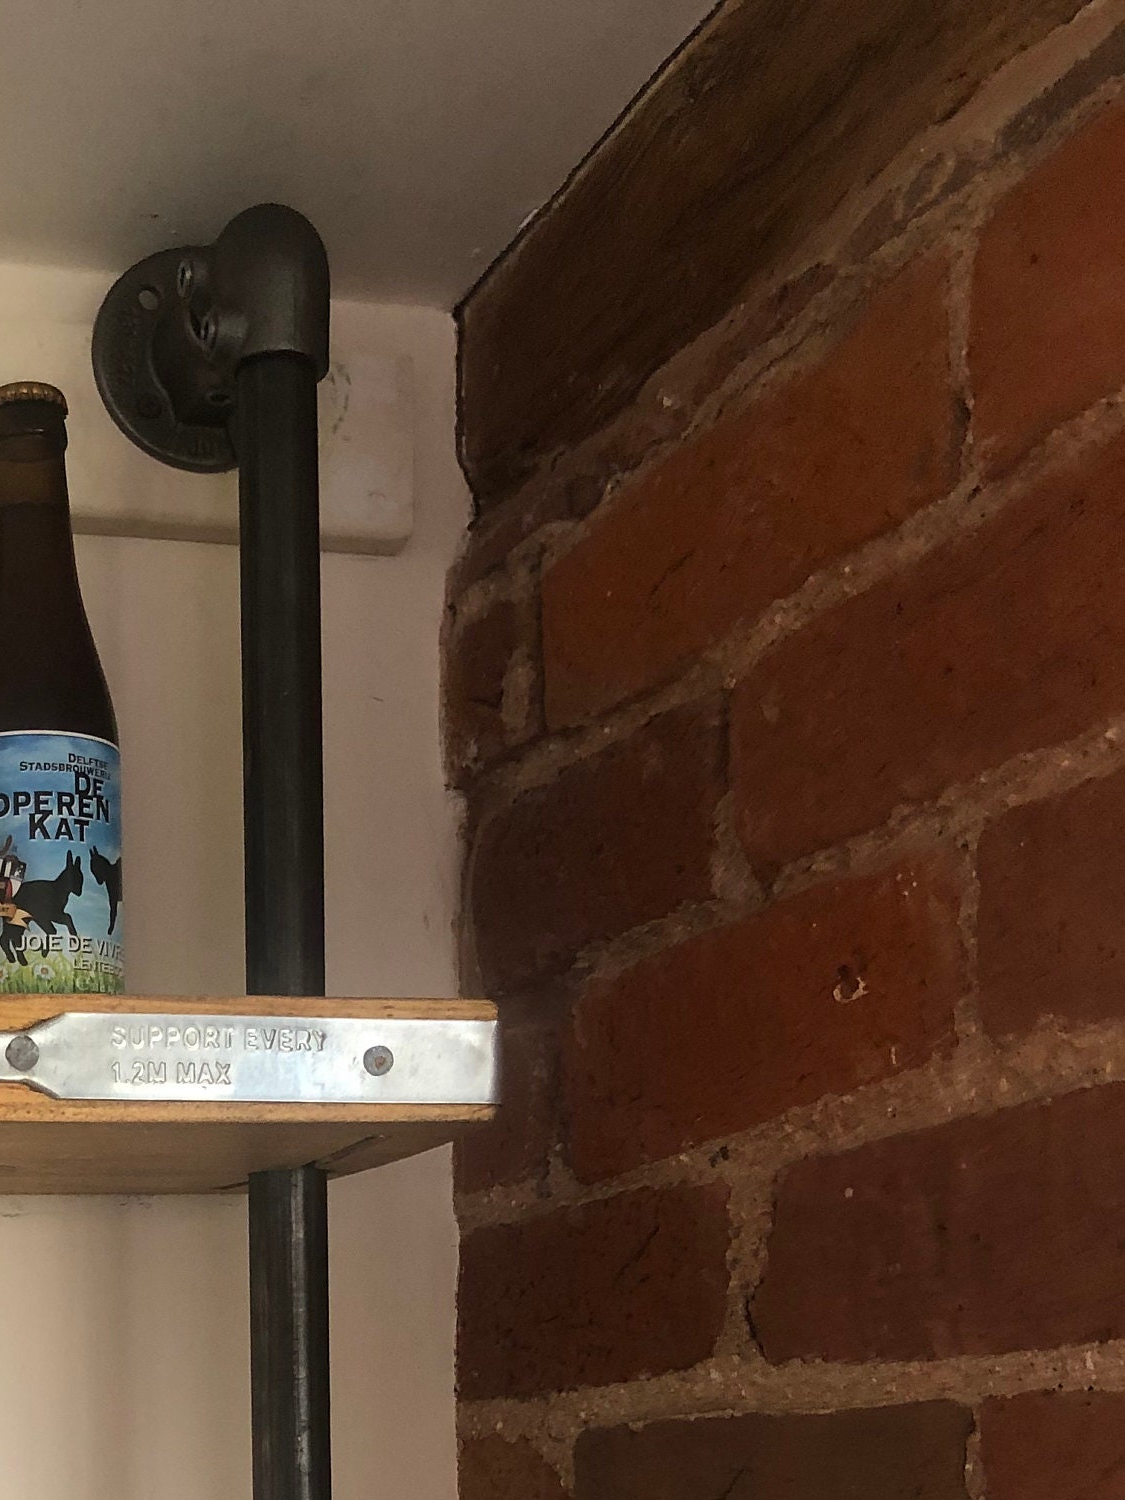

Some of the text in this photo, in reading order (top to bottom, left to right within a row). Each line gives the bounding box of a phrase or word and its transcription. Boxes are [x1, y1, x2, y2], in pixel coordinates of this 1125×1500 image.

[68, 753, 108, 770] DELFTSE
[74, 772, 104, 798] DE
[28, 812, 91, 843] KAT
[16, 934, 62, 952] JOIE
[67, 935, 93, 954] DE
[111, 1023, 328, 1053] SUPPORT EVERY
[112, 1060, 233, 1086] 1.2M MAX
